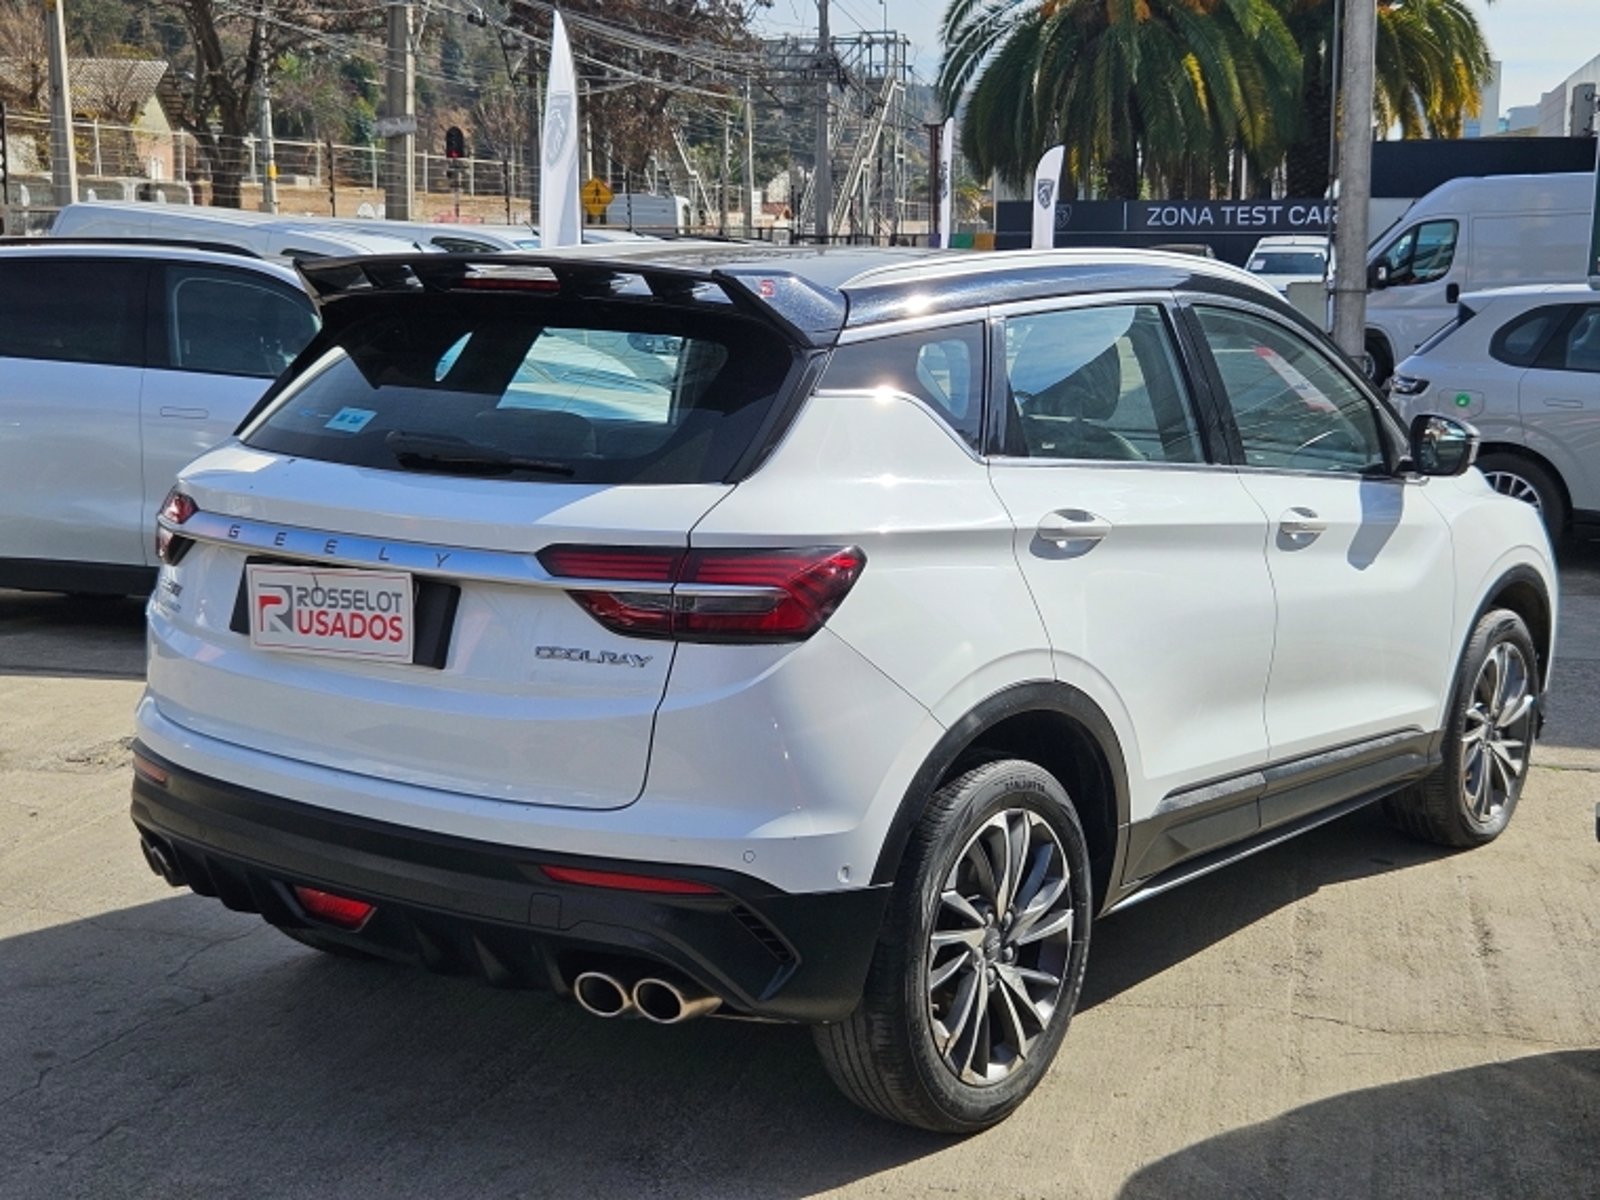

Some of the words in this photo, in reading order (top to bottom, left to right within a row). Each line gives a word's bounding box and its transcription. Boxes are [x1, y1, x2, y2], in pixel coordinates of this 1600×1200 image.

[1147, 207, 1214, 226] ZONA
[1221, 206, 1283, 225] TEST
[228, 524, 451, 568] GEELY
[296, 586, 403, 613] ROSSELOT
[297, 609, 404, 642] USADOS
